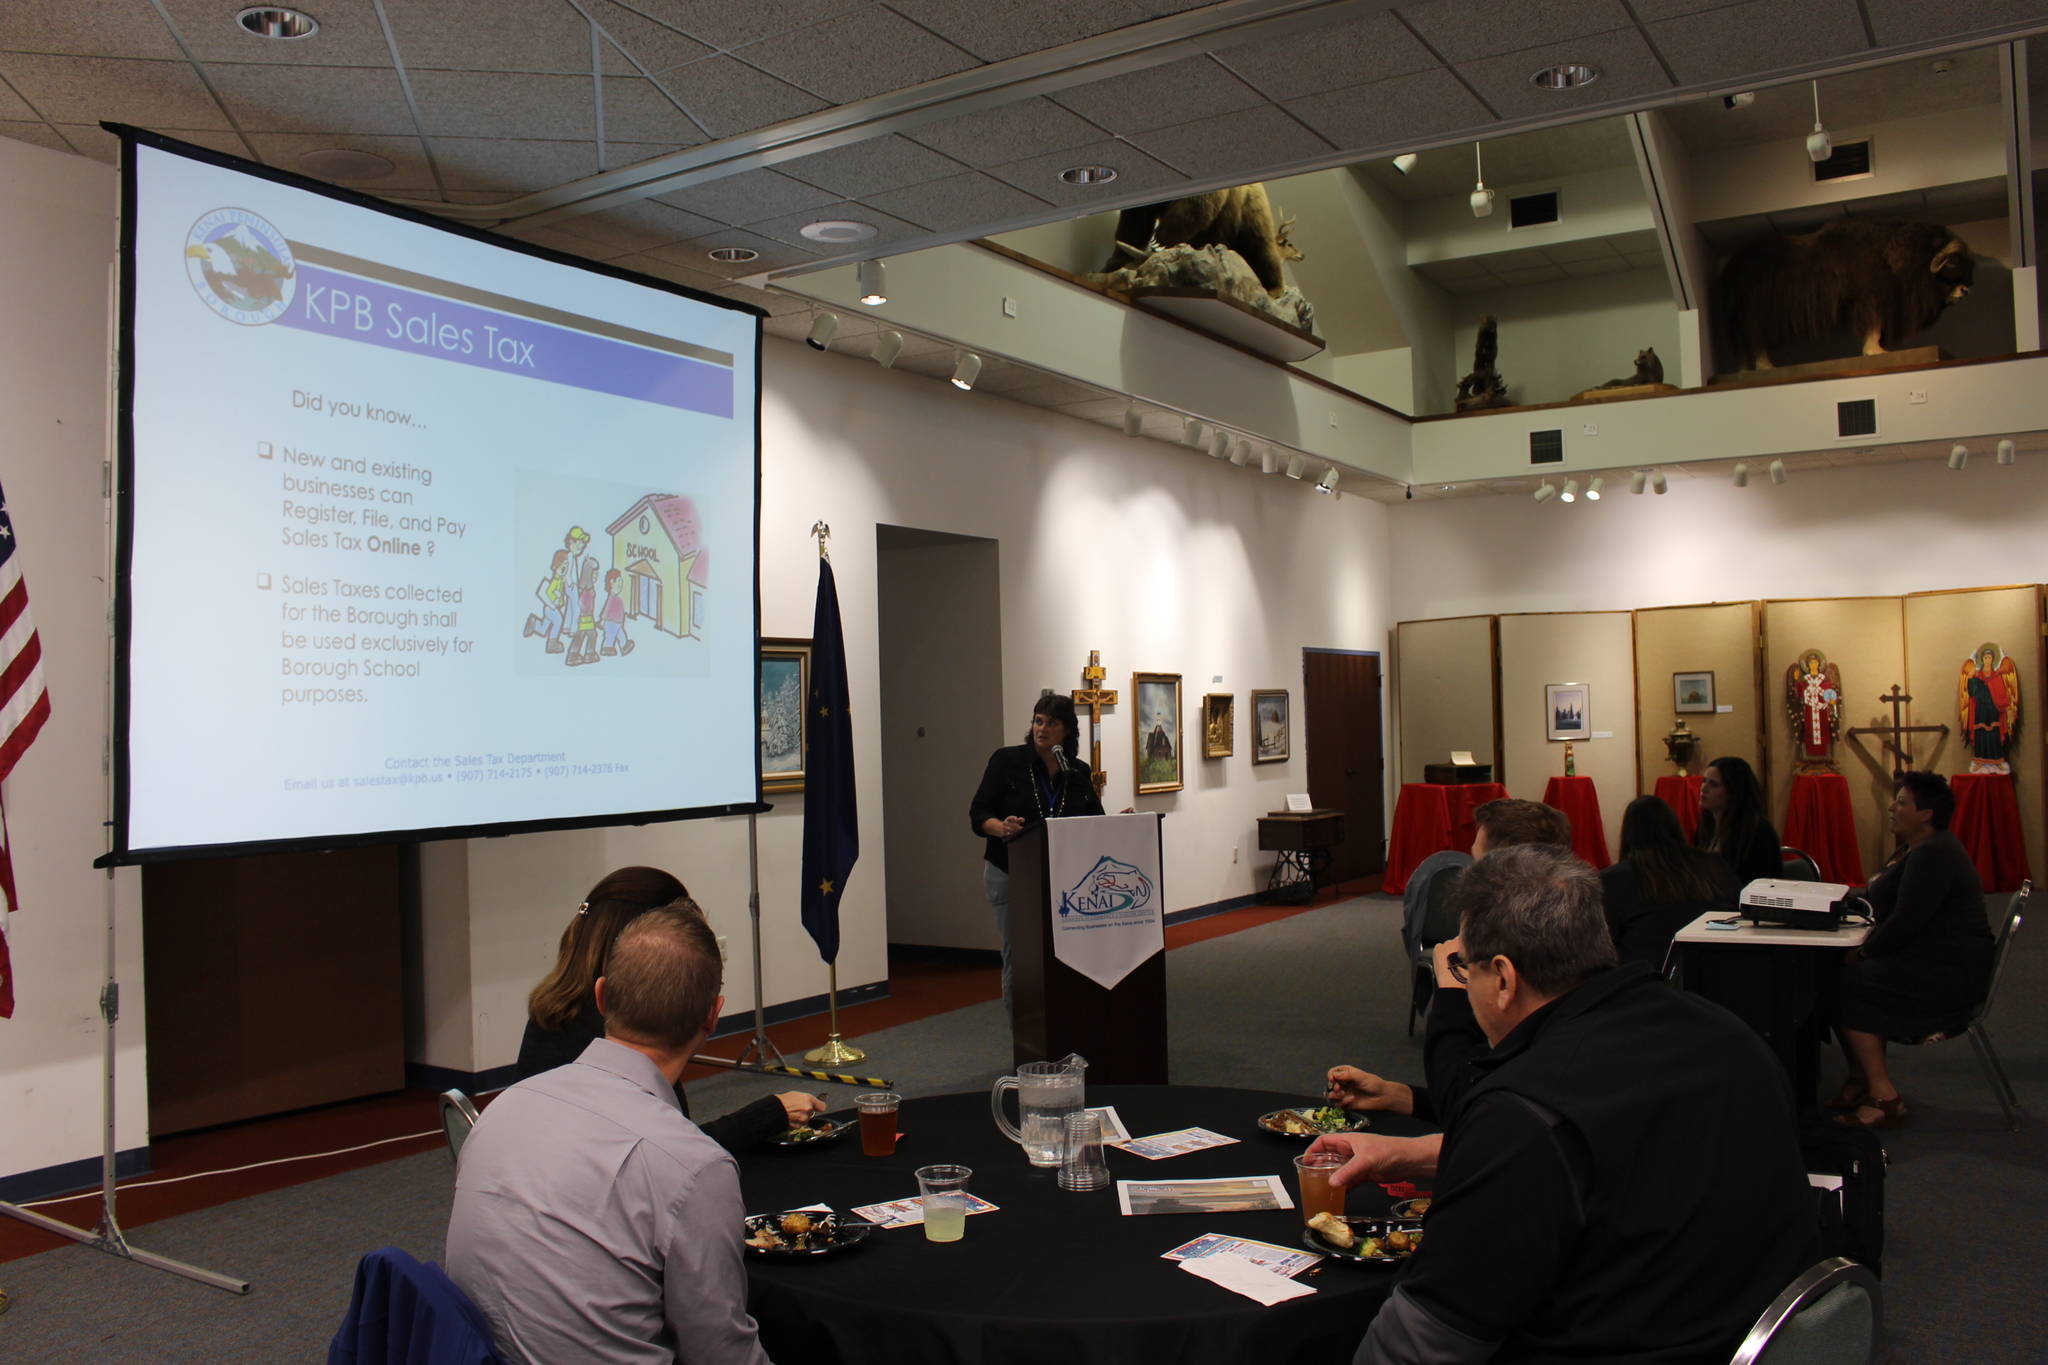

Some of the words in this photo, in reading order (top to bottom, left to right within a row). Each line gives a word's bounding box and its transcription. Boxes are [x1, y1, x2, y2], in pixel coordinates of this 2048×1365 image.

[306, 283, 374, 331] KPB
[386, 303, 473, 354] Sales
[484, 325, 535, 368] Tax
[292, 390, 323, 411] Did
[329, 401, 361, 417] you
[366, 403, 428, 429] know...
[283, 447, 325, 467] New
[331, 457, 367, 474] and
[372, 461, 432, 485] existing
[283, 475, 375, 500] businesses
[380, 489, 413, 505] can
[283, 500, 357, 525] Register,
[363, 509, 394, 529] File,
[399, 516, 432, 532] and
[437, 517, 466, 538] Pay
[282, 527, 328, 548] Sales
[333, 532, 362, 551] Tax
[367, 535, 421, 556] Online
[427, 541, 435, 557] ?
[626, 542, 659, 562] SCHOOL
[282, 575, 328, 595] Sales
[333, 579, 380, 599] Taxes
[385, 584, 463, 603] collected
[282, 602, 306, 621] for
[312, 605, 341, 622] the
[347, 606, 418, 629] Borough
[423, 611, 457, 628] shall
[282, 631, 307, 649] be
[313, 633, 355, 650] used
[361, 635, 448, 656] exclusively
[453, 637, 474, 653] for
[282, 657, 358, 680] Borough
[363, 659, 420, 677] School
[282, 687, 368, 706] purposes.
[384, 757, 429, 769] Contact
[433, 756, 450, 767] the
[455, 755, 483, 767] Sales
[487, 754, 503, 765] Tax
[508, 752, 566, 766] Department
[284, 778, 317, 791] Email
[321, 778, 335, 789] us
[339, 777, 351, 788] at
[456, 769, 484, 783] (907)
[544, 764, 570, 777] (907)
[615, 762, 629, 773] Fax
[1059, 889, 1113, 917] KENAI
